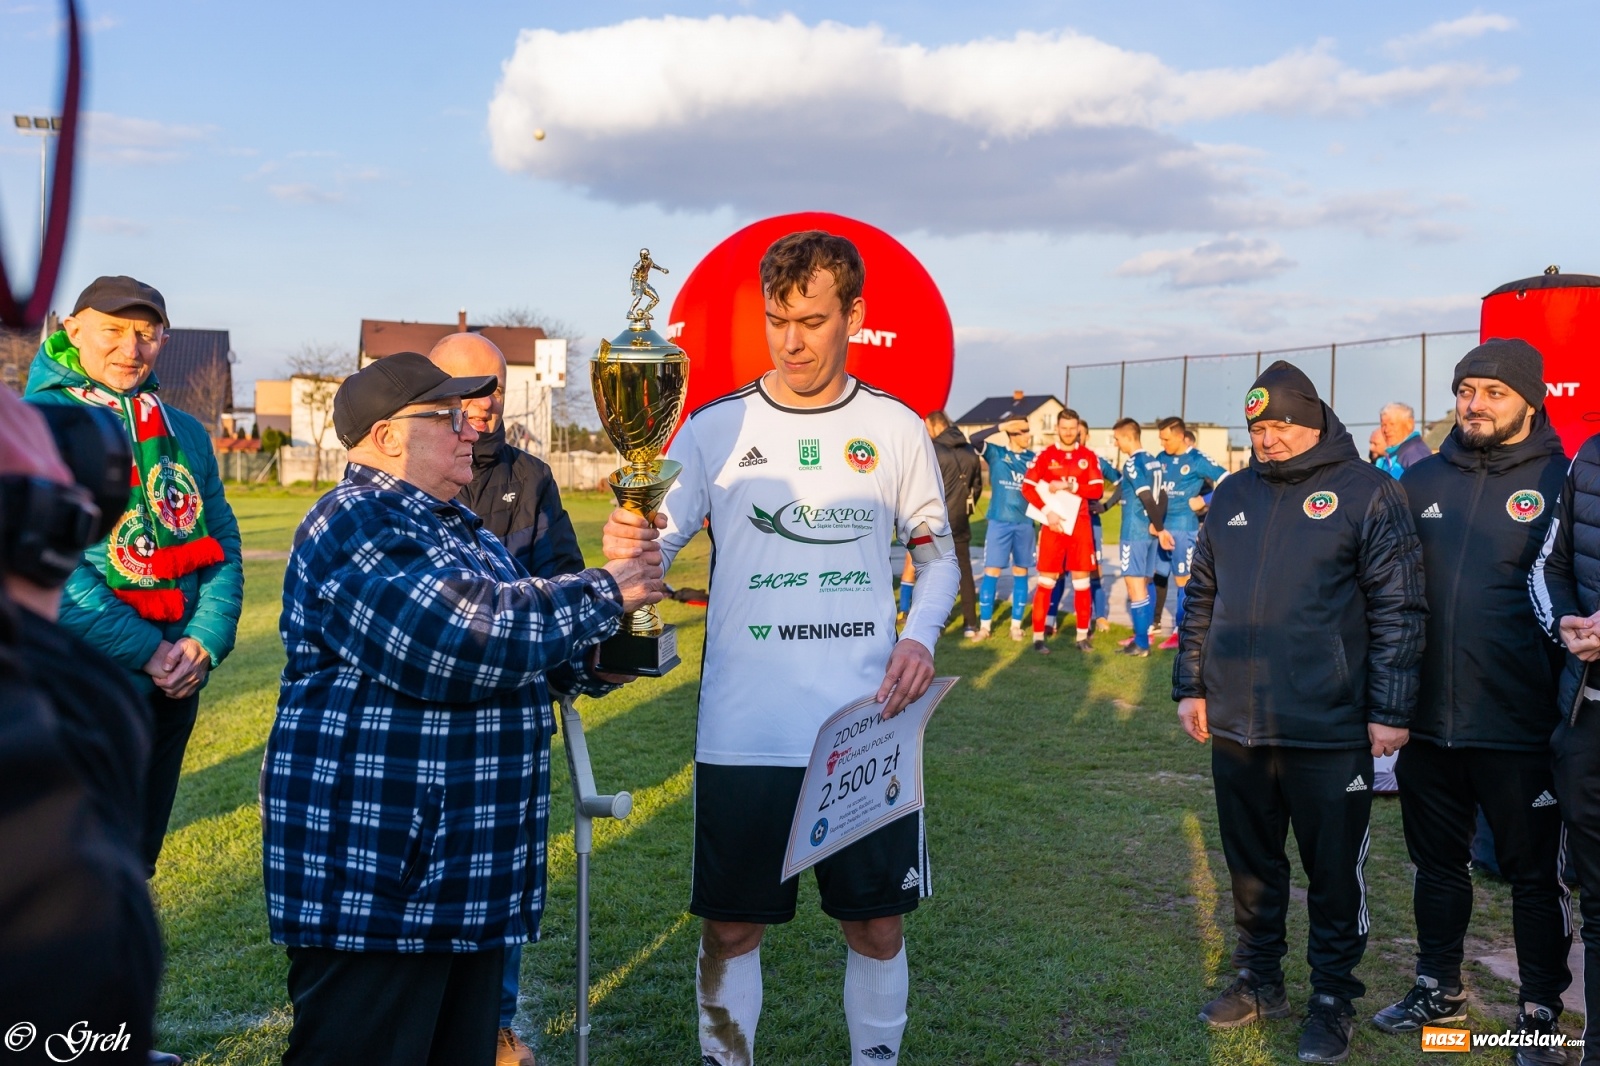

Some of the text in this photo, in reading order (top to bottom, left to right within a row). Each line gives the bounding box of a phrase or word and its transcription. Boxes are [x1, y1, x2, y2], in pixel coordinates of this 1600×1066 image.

[802, 446, 817, 458] BS
[738, 457, 768, 468] adidas
[502, 492, 516, 502] 4F
[792, 505, 875, 529] REKPOL
[748, 572, 809, 590] SACHS
[778, 621, 875, 640] WENINGER
[838, 743, 871, 767] PUCHARU
[871, 731, 895, 749] POLSKI
[818, 744, 900, 812] 2.500 zł
[1346, 784, 1368, 792] adidas
[1532, 799, 1558, 807] adidas
[861, 1049, 896, 1060] adidas
